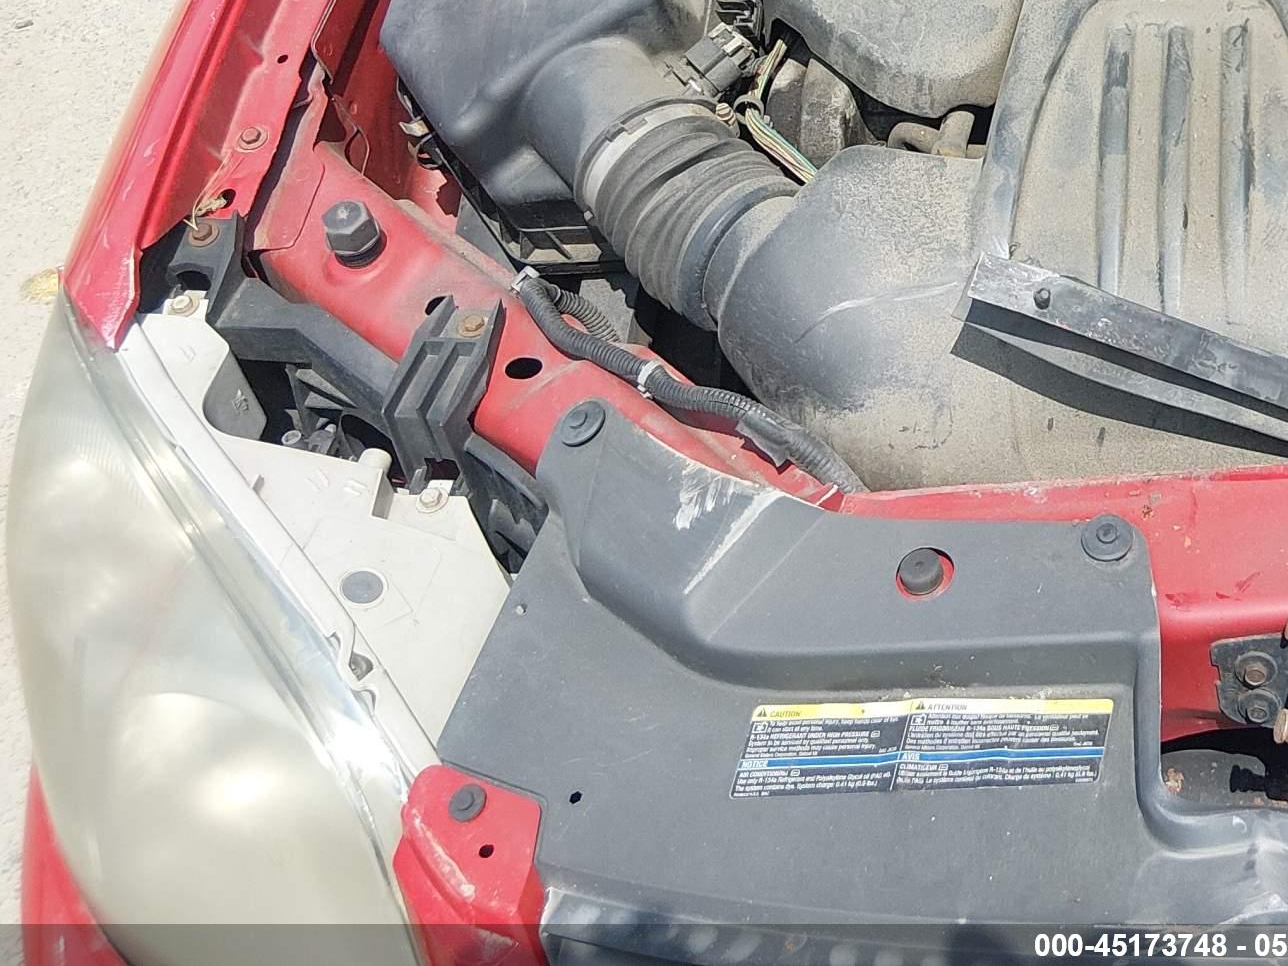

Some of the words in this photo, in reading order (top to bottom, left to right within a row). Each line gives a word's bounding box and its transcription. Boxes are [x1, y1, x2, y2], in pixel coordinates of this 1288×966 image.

[928, 703, 967, 711] ATTENTION
[770, 710, 801, 718] CAUTION
[902, 752, 920, 761] AVIS
[742, 760, 768, 768] NOTICE
